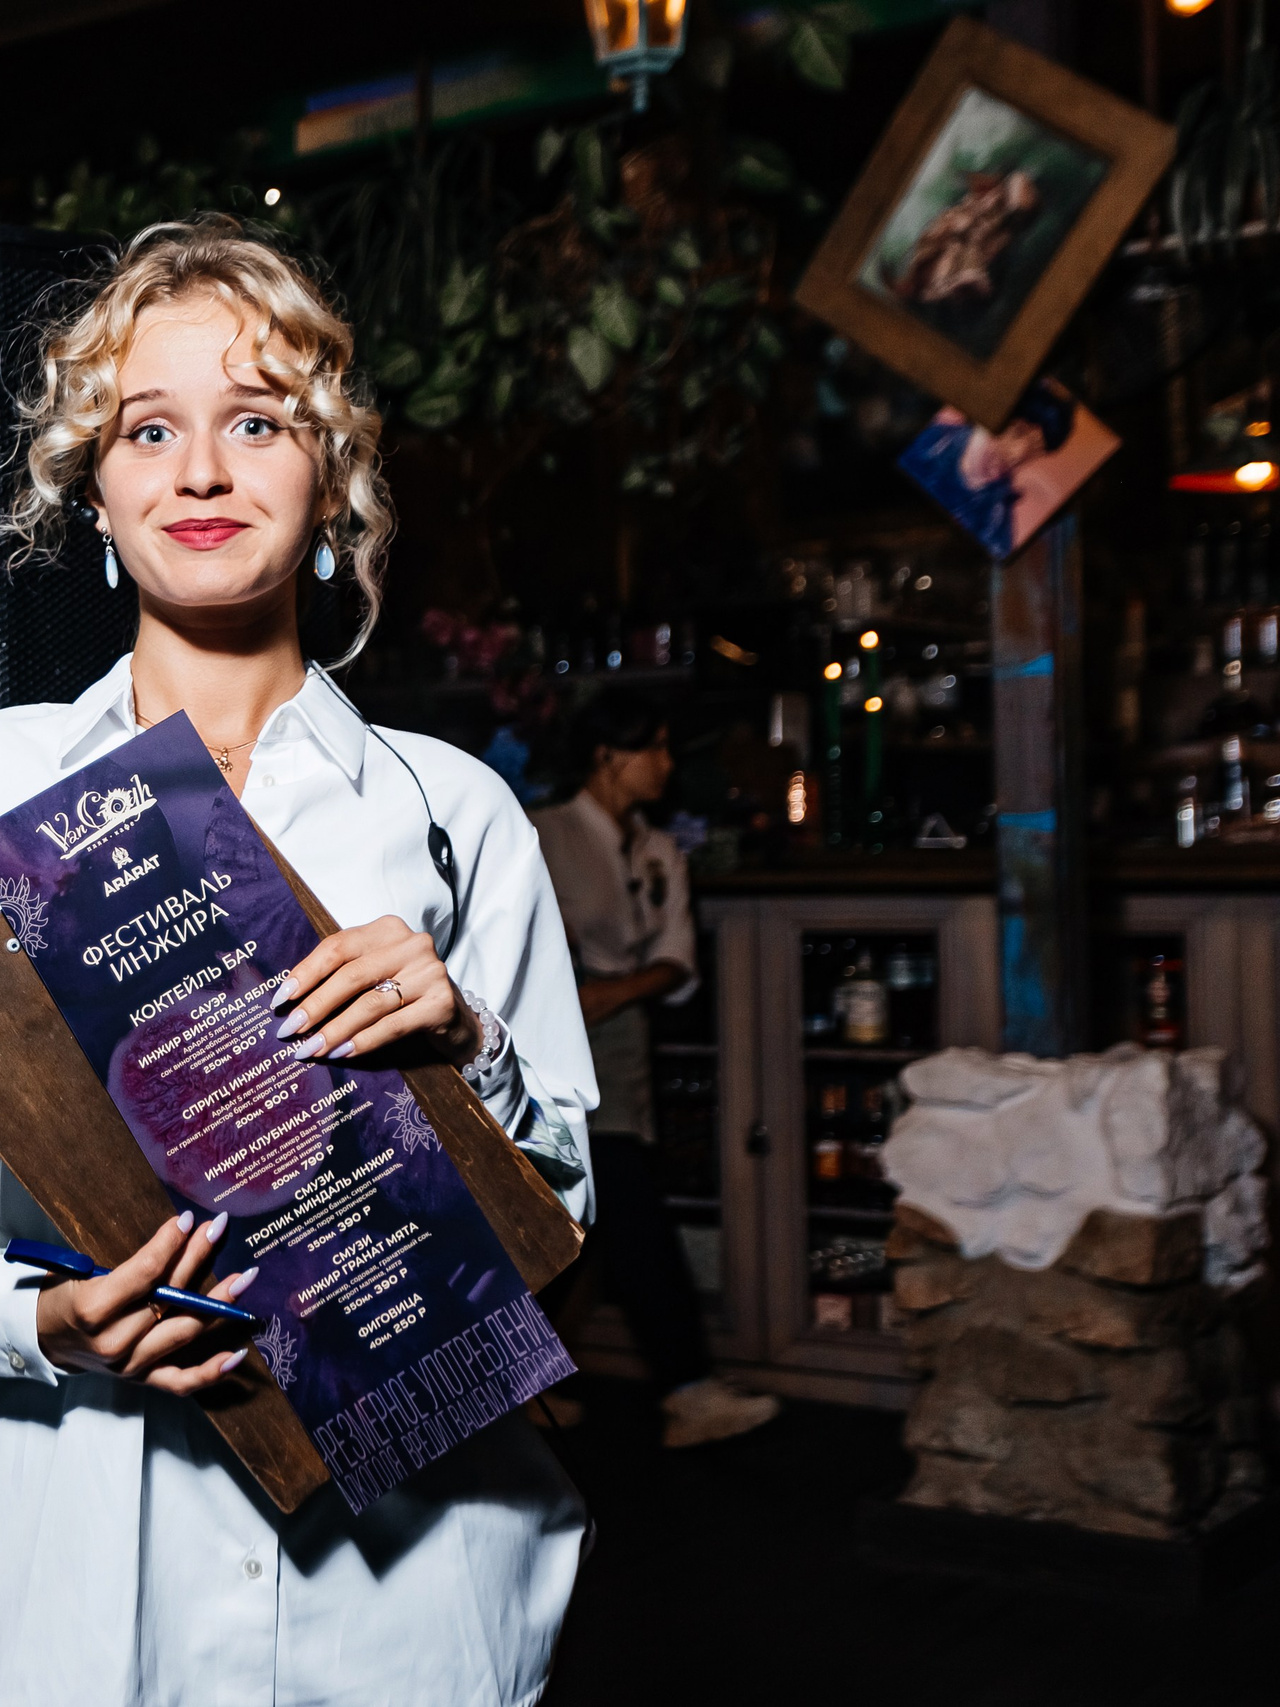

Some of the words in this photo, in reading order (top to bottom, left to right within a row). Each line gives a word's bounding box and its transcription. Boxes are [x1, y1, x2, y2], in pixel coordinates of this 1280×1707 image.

[36, 812, 88, 853] Van
[76, 774, 154, 830] Gogh
[82, 870, 232, 966] ФЕСТИВАЛЬ
[109, 902, 230, 982] ИНЖИРА
[129, 966, 222, 1028] КОКТЕЙЛЬ
[221, 940, 257, 971] БАР
[190, 992, 227, 1020] САУЭР
[138, 1036, 182, 1069] ИНЖИР
[182, 997, 247, 1042] ВИНОГРАД
[246, 969, 291, 1004] ЯБЛОКО
[189, 1050, 216, 1070] свежий
[239, 1016, 273, 1039] виноград
[213, 1024, 228, 1036] лет,
[226, 1011, 248, 1027] трипл
[232, 1035, 257, 1056] 900
[160, 1067, 174, 1078] сок
[230, 1023, 244, 1035] сок
[182, 1085, 231, 1120] СПРИТЦ
[228, 1058, 272, 1092] ИНЖИР
[242, 1087, 257, 1100] лет,
[255, 1074, 277, 1091] ликер
[264, 1090, 289, 1110] 900
[166, 1145, 180, 1157] сок
[178, 1131, 204, 1149] гранат,
[202, 1111, 234, 1134] игристое
[252, 1086, 274, 1103] сироп
[204, 1148, 248, 1182] ИНЖИР
[248, 1110, 312, 1154] КЛУБНИКА
[310, 1079, 358, 1114] СЛИВКИ
[265, 1148, 280, 1160] лет,
[279, 1135, 301, 1152] ликер
[299, 1124, 318, 1138] Вана
[213, 1178, 249, 1203] кокосовое
[274, 1147, 297, 1164] сироп
[320, 1120, 340, 1135] пюре
[273, 1155, 300, 1175] свежий
[298, 1141, 323, 1159] инжир
[294, 1169, 335, 1201] СМУЗИ
[300, 1151, 325, 1171] 790
[244, 1211, 295, 1248] ТРОПИК
[293, 1177, 352, 1218] МИНДАЛЬ
[351, 1148, 395, 1181] ИНЖИР
[253, 1238, 280, 1259] свежий
[303, 1207, 329, 1227] молоко
[350, 1180, 373, 1197] сироп
[316, 1214, 335, 1229] пюре
[334, 1187, 378, 1217] тропическое
[337, 1212, 362, 1232] 390
[297, 1269, 341, 1304] ИНЖИР
[341, 1240, 385, 1275] ГРАНАТ
[385, 1221, 419, 1247] МЯТА
[332, 1234, 373, 1265] СМУЗИ
[299, 1297, 326, 1318] свежий
[378, 1238, 418, 1267] гранатовый
[337, 1286, 360, 1304] сироп
[385, 1259, 403, 1273] мята
[373, 1274, 398, 1295] 390
[358, 1292, 423, 1338] ФИГОВИЦА
[392, 1313, 417, 1334] 250
[410, 1291, 557, 1410] УПОТРЕБЛЕНИЕ
[400, 1410, 458, 1469] ВРЕДИТ
[448, 1377, 509, 1439] ВАШЕМУ
